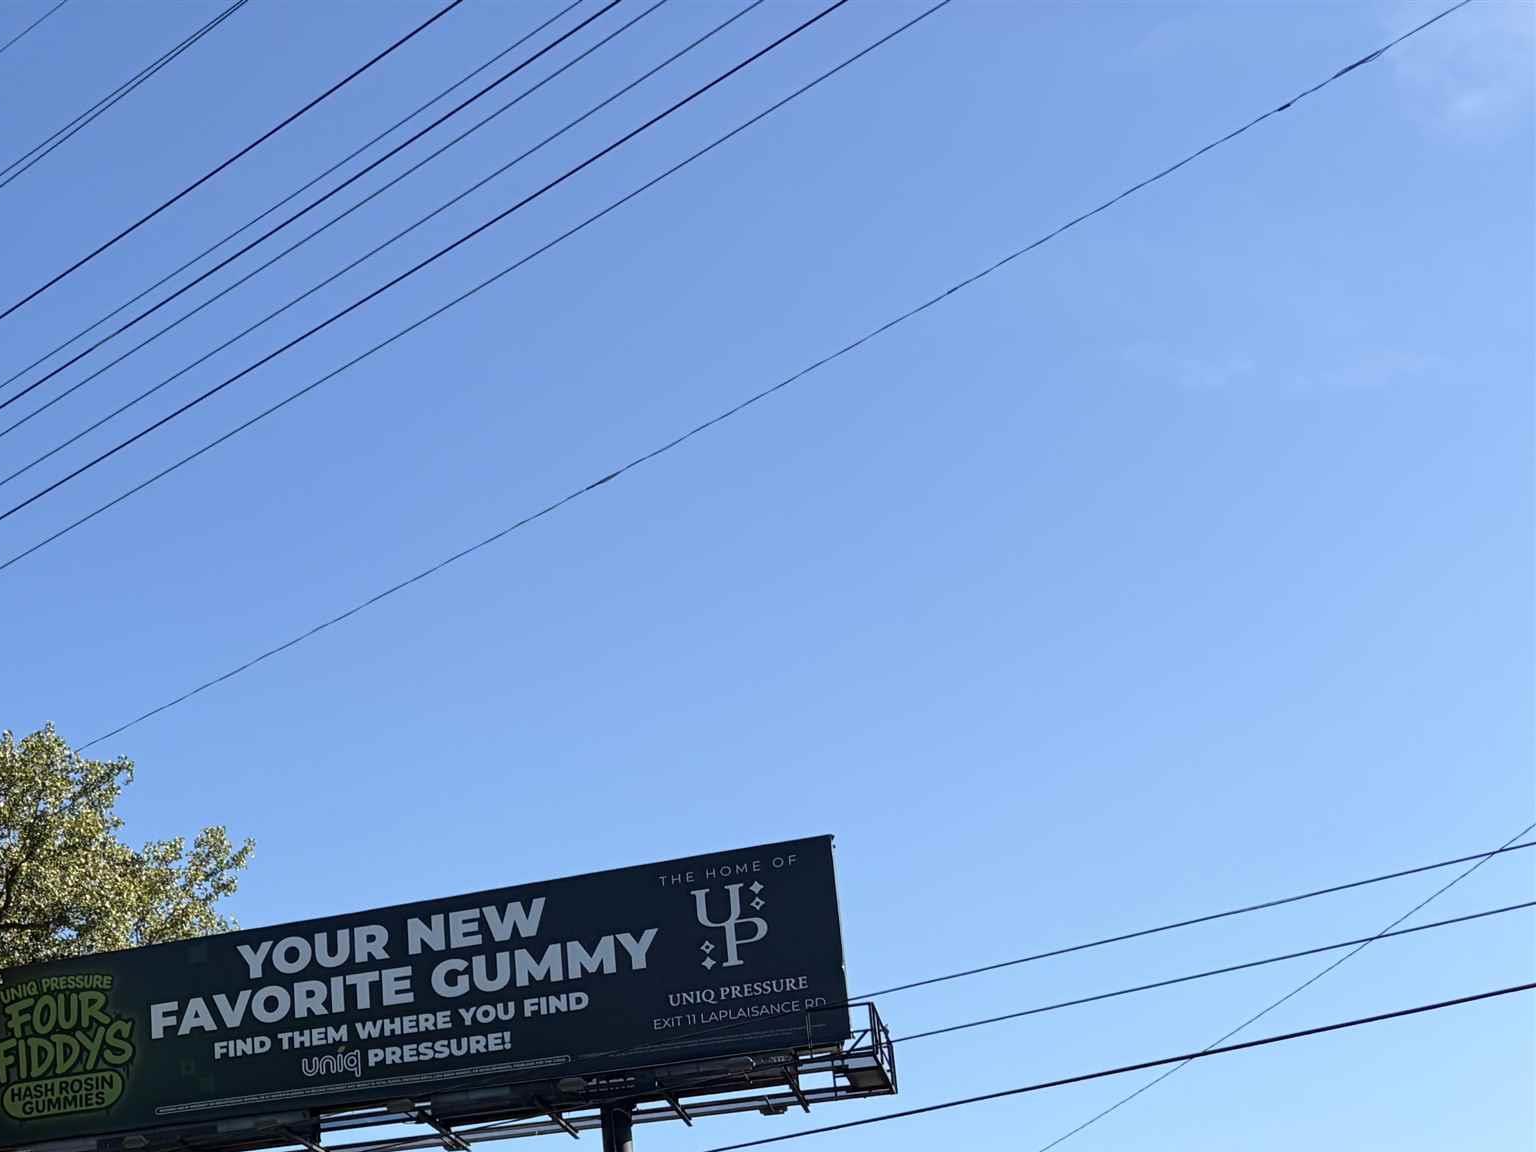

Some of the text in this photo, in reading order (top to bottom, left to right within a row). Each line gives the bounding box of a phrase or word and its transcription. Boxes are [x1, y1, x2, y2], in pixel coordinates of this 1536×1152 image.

[659, 854, 798, 887] THE HOME OF
[236, 897, 546, 980] YOUR NEW
[0, 975, 113, 1003] UNIQ PRESSURE
[150, 928, 658, 1040] FAVORITE GUMMY
[669, 976, 809, 1007] UNIQ PRESSURE
[5, 991, 111, 1038] FOUR
[214, 991, 589, 1060] FIND THEM WHERE YOU FIND
[653, 1015, 683, 1030] EXIT
[686, 1014, 696, 1025] 11
[700, 1000, 801, 1023] LAPLAISANCE
[301, 1031, 513, 1078] uniq PRESSURE!
[11, 1074, 114, 1102] HASH ROSIN
[22, 1091, 105, 1115] GUMMIES
